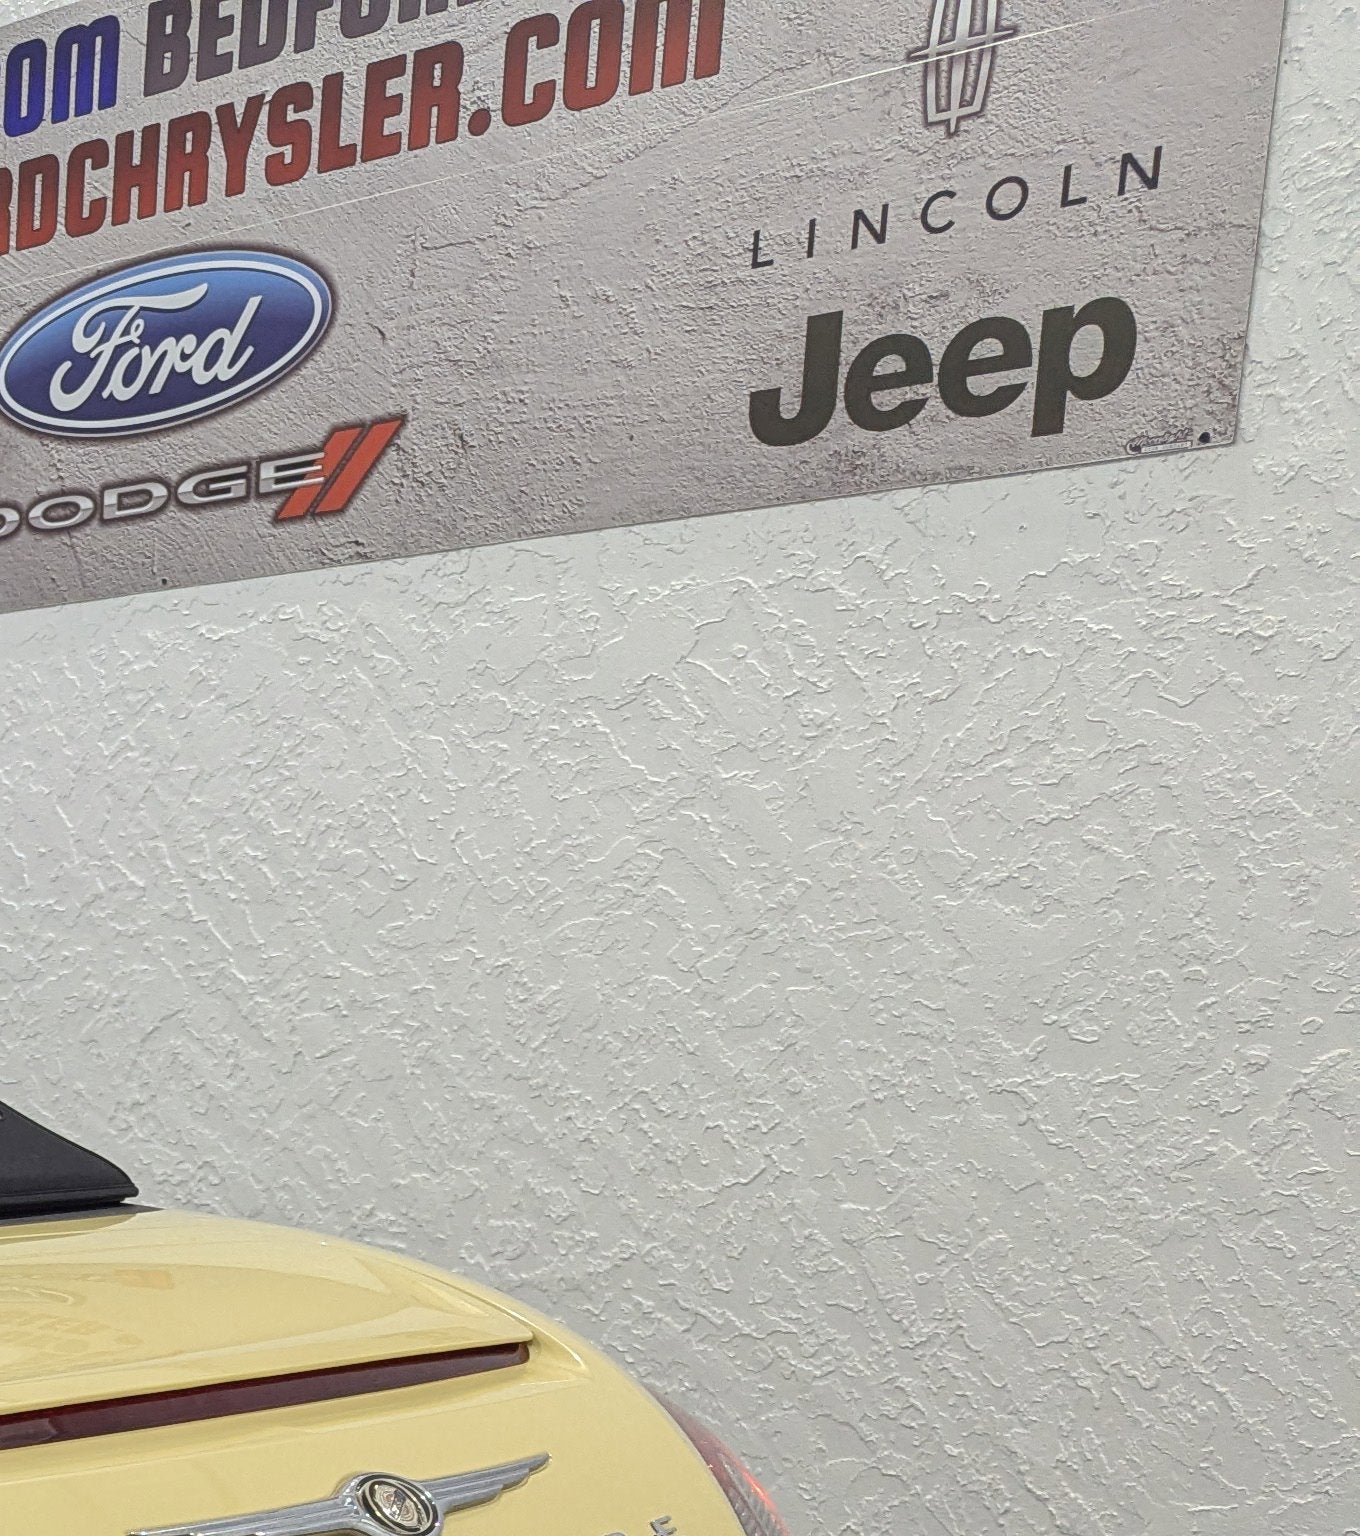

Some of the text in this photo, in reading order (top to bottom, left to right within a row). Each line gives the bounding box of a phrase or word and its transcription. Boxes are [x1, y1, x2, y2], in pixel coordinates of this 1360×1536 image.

[750, 146, 1164, 269] LINCOLN
[48, 282, 264, 414] Ford
[748, 295, 1138, 447] Jeep
